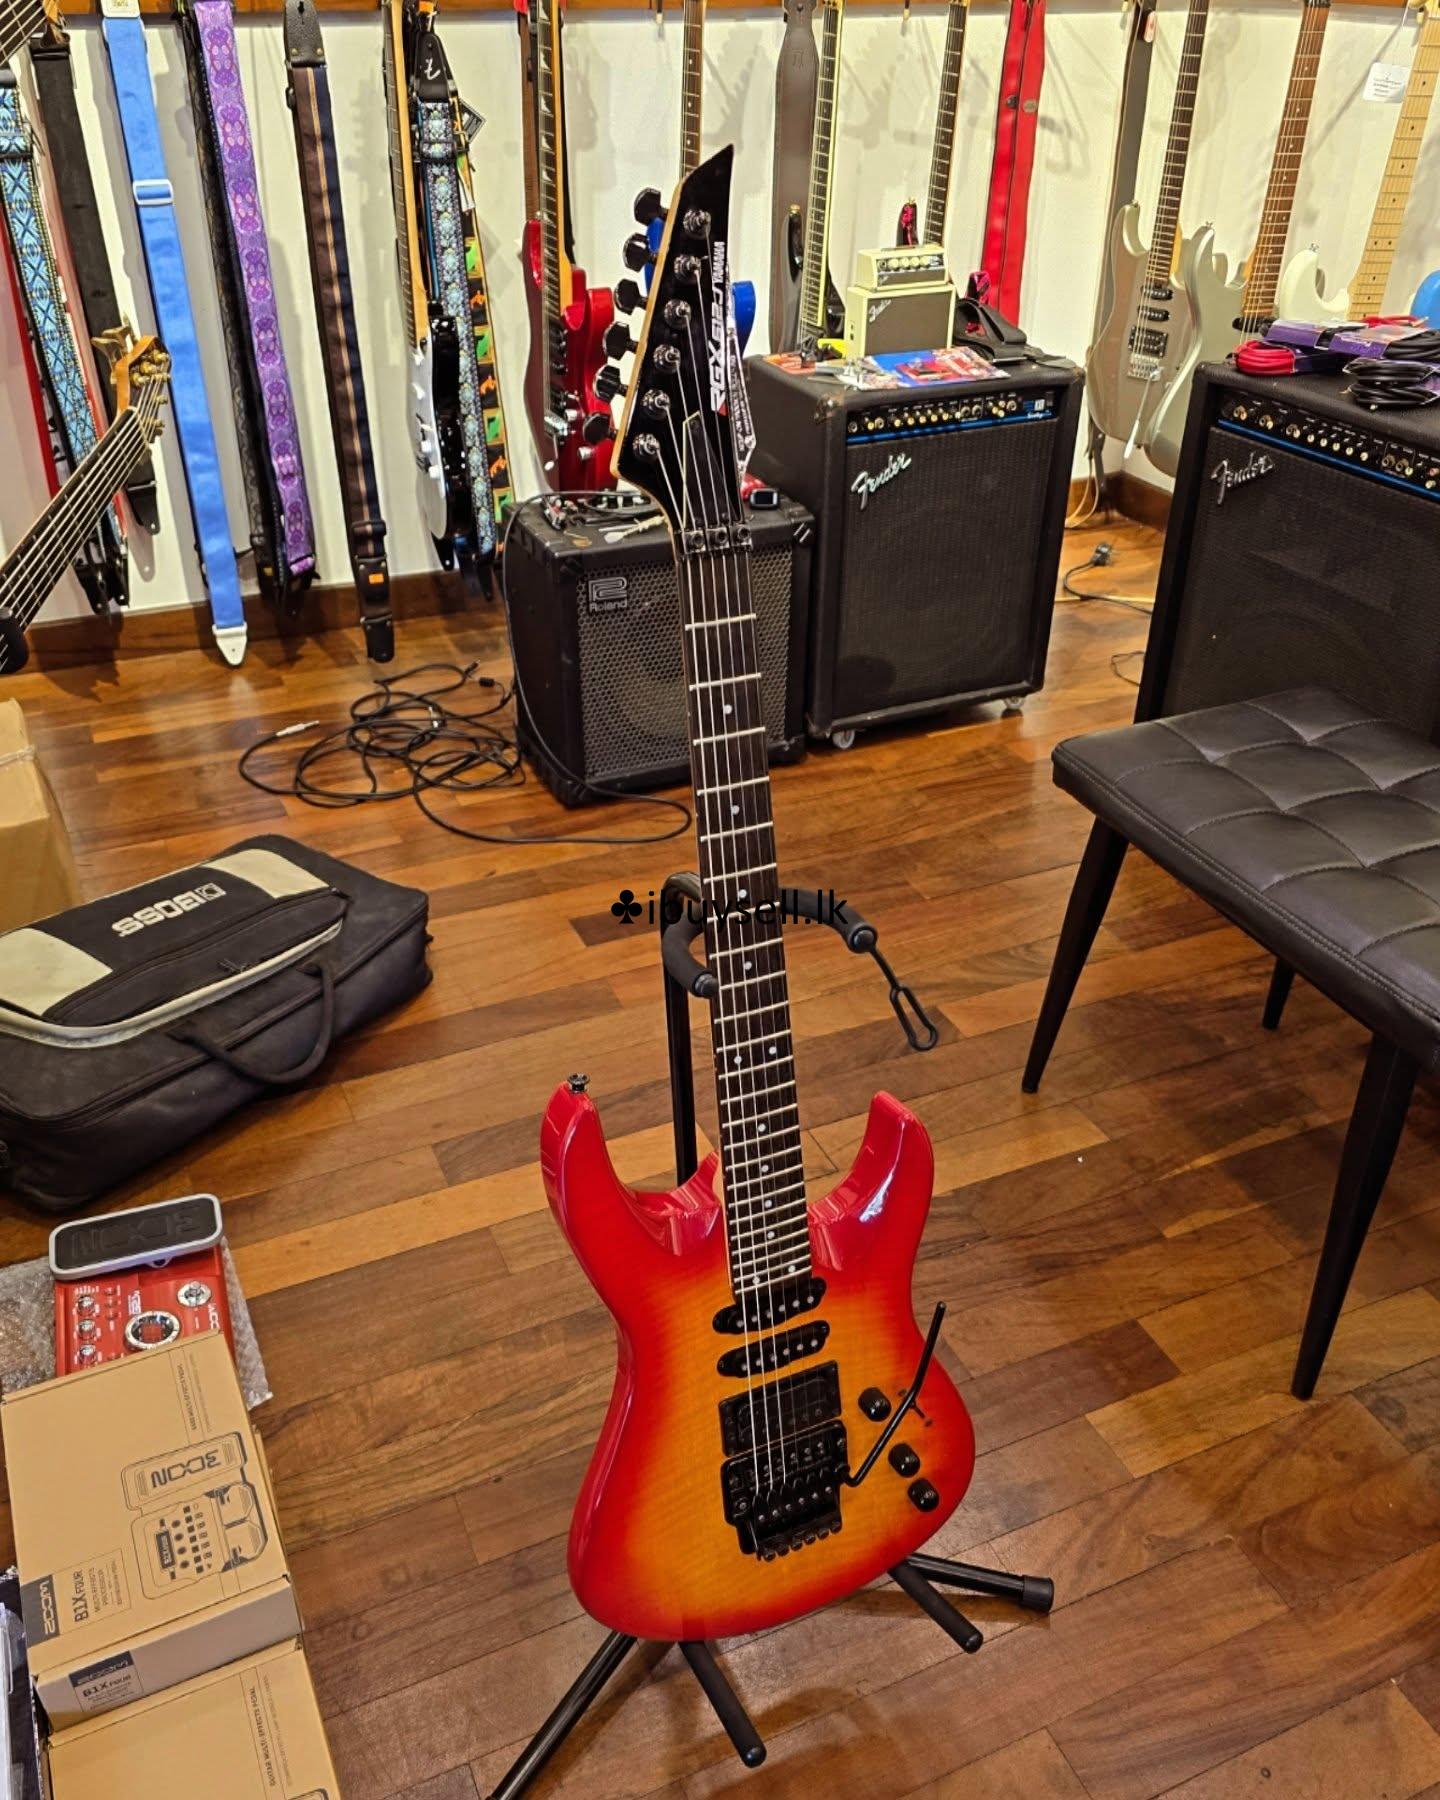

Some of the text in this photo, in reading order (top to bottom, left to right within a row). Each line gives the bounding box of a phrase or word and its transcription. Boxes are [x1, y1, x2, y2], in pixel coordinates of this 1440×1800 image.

[711, 241, 726, 283] YAMAHA
[850, 453, 912, 510] Fender
[1210, 452, 1276, 505] Fender
[589, 599, 628, 613] Roland
[111, 890, 208, 938] BOSS
[150, 1448, 221, 1488] ZOOM
[38, 1580, 57, 1635] ZOOM
[72, 1594, 90, 1623] B1X
